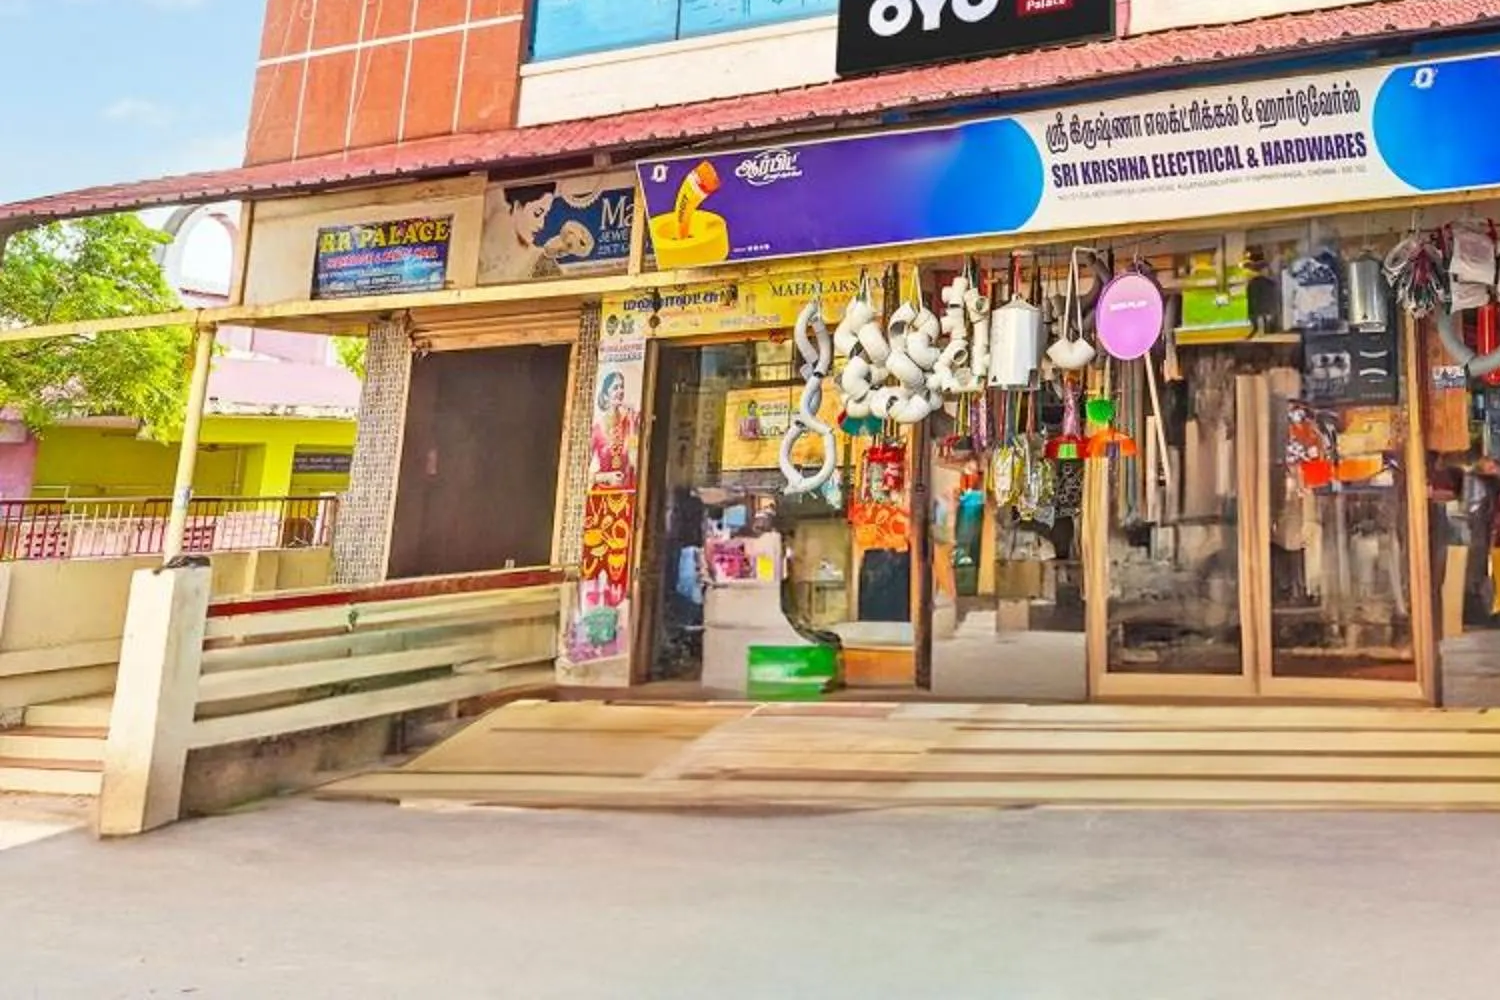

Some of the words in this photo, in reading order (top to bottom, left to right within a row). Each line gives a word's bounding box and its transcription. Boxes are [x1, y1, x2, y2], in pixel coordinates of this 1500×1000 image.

[1242, 95, 1252, 123] &
[1051, 162, 1079, 189] SRI
[1081, 154, 1150, 187] KRISHNA
[1152, 145, 1244, 179] ELECTRICAL
[1246, 147, 1259, 168] &
[1261, 131, 1368, 166] HARDWARES
[357, 220, 449, 249] PALACE
